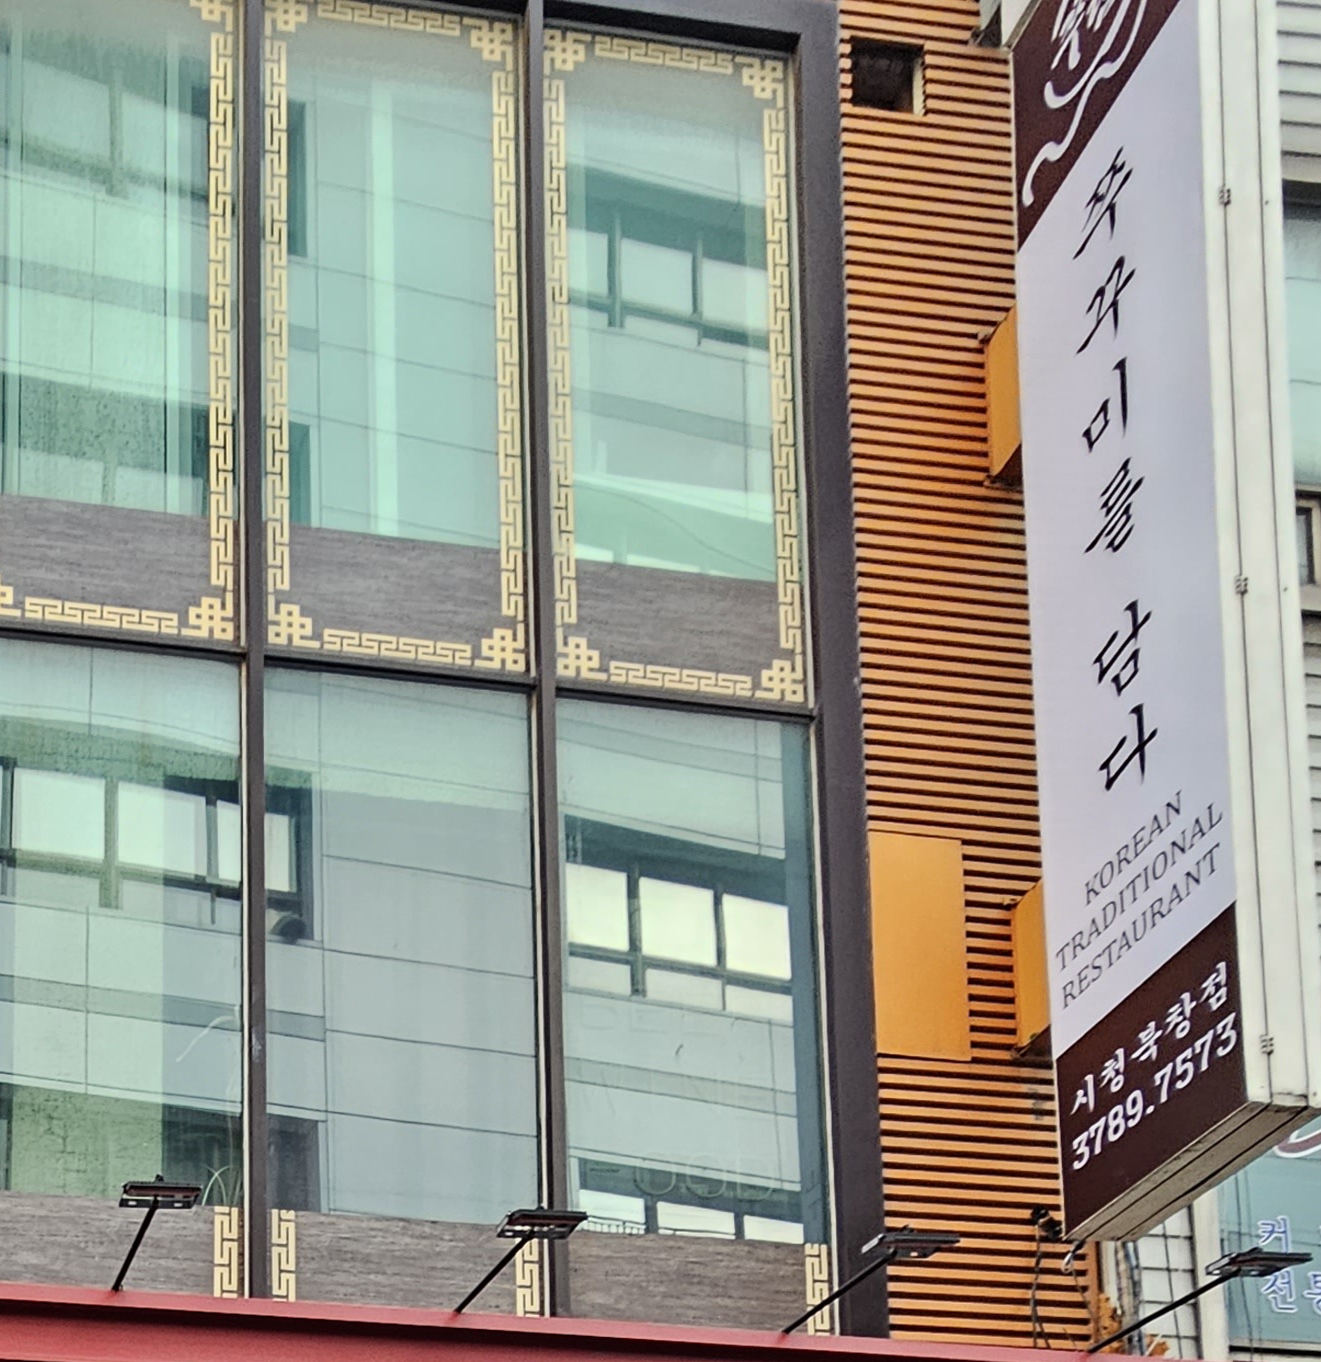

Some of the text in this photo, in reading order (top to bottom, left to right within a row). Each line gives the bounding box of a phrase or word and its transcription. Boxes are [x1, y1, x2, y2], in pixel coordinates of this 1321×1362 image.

[1072, 145, 1145, 553] 쭈꾸미를
[1092, 599, 1158, 791] 담다
[1055, 802, 1224, 971] TRADITIONAL
[1061, 843, 1222, 1009] RESTAURANT
[1085, 789, 1183, 906] KOREAN
[1069, 961, 1228, 1117] 시청북창점
[1072, 1013, 1238, 1171] 3789.7573
